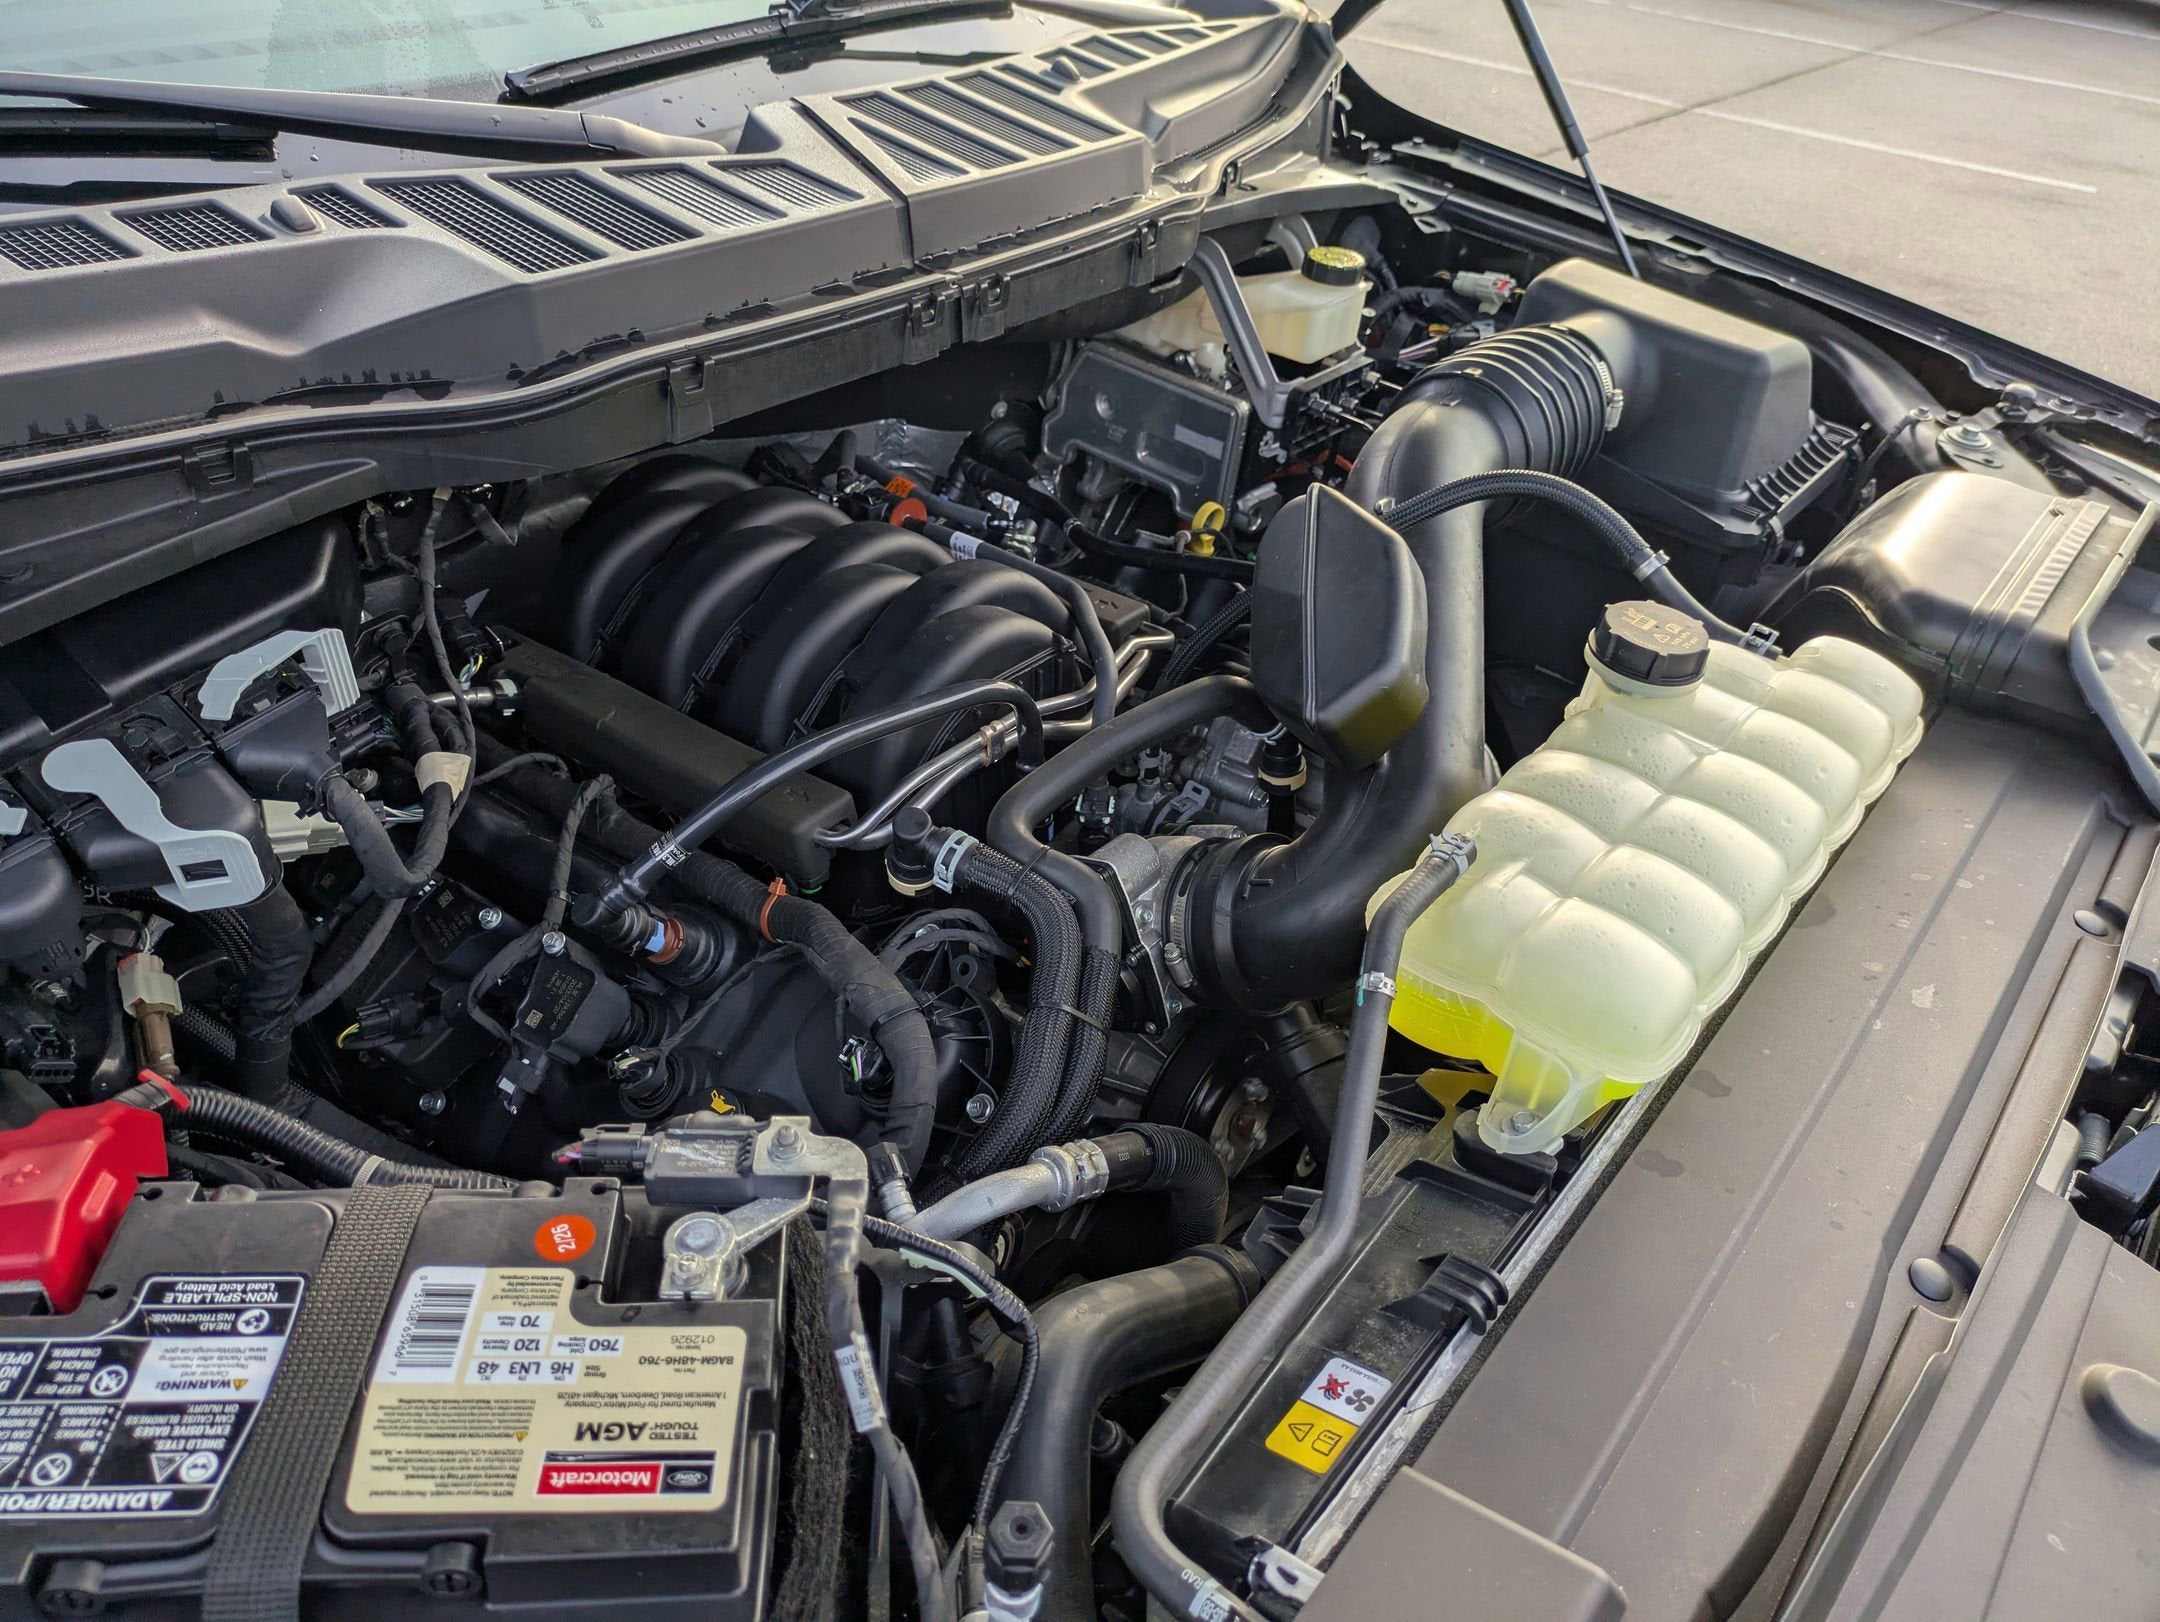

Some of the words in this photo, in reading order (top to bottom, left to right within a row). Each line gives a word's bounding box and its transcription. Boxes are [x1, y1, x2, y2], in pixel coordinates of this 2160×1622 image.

[550, 1223, 576, 1254] 2/26
[530, 1273, 549, 1281] Motor
[549, 1273, 564, 1281] Ford
[175, 1280, 217, 1292] Battery
[218, 1280, 246, 1292] Acid
[247, 1280, 275, 1292] Lead
[515, 1280, 563, 1288] Recommended
[162, 1291, 279, 1304] NON-SPILLABLE
[150, 1312, 236, 1323] INSTRUCTIONS.
[520, 1314, 540, 1328] 70
[199, 1321, 232, 1331] READ
[670, 1334, 716, 1344] 012926
[514, 1338, 540, 1352] 120
[589, 1338, 619, 1352] 760
[196, 1354, 215, 1362] after
[216, 1354, 242, 1362] hands
[243, 1354, 267, 1362] Wash
[638, 1355, 734, 1365] BAGM-48H6-760
[45, 1359, 62, 1370] OF
[61, 1359, 96, 1370] REACH
[195, 1362, 249, 1370] Reproductive
[476, 1361, 500, 1375] 48
[509, 1361, 541, 1375] LN3
[550, 1361, 574, 1375] H6
[50, 1372, 74, 1383] THE
[73, 1372, 90, 1383] OF
[179, 1370, 197, 1378] and
[200, 1370, 229, 1378] Cancer
[583, 1370, 607, 1378] Group
[33, 1383, 58, 1395] OUT
[57, 1383, 84, 1395] KEEP
[154, 1378, 231, 1391] WARNING:
[583, 1391, 619, 1400] Michigan
[620, 1391, 660, 1400] Dearborn,
[660, 1391, 684, 1400] Road,
[684, 1391, 722, 1400] American
[223, 1403, 239, 1414] OR
[564, 1400, 602, 1409] Company
[603, 1400, 627, 1409] Motor
[627, 1400, 647, 1409] Ford
[647, 1400, 660, 1409] for
[660, 1400, 717, 1409] Manufactured
[58, 1405, 107, 1417] SMOKING
[60, 1417, 102, 1428] FLAMES
[124, 1414, 181, 1425] BLINDNESS
[181, 1414, 213, 1425] CAUSE
[213, 1414, 235, 1425] CAN
[54, 1428, 96, 1440] SPARKS
[133, 1424, 171, 1438] GASES
[171, 1424, 231, 1438] EXPLOSIVE
[574, 1421, 649, 1442] AGM
[649, 1431, 698, 1440] TESTED
[79, 1440, 98, 1452] NO
[185, 1438, 226, 1451] SHIELD
[549, 1471, 651, 1488] Motorcraft
[1181, 1568, 1204, 1590] RAD
